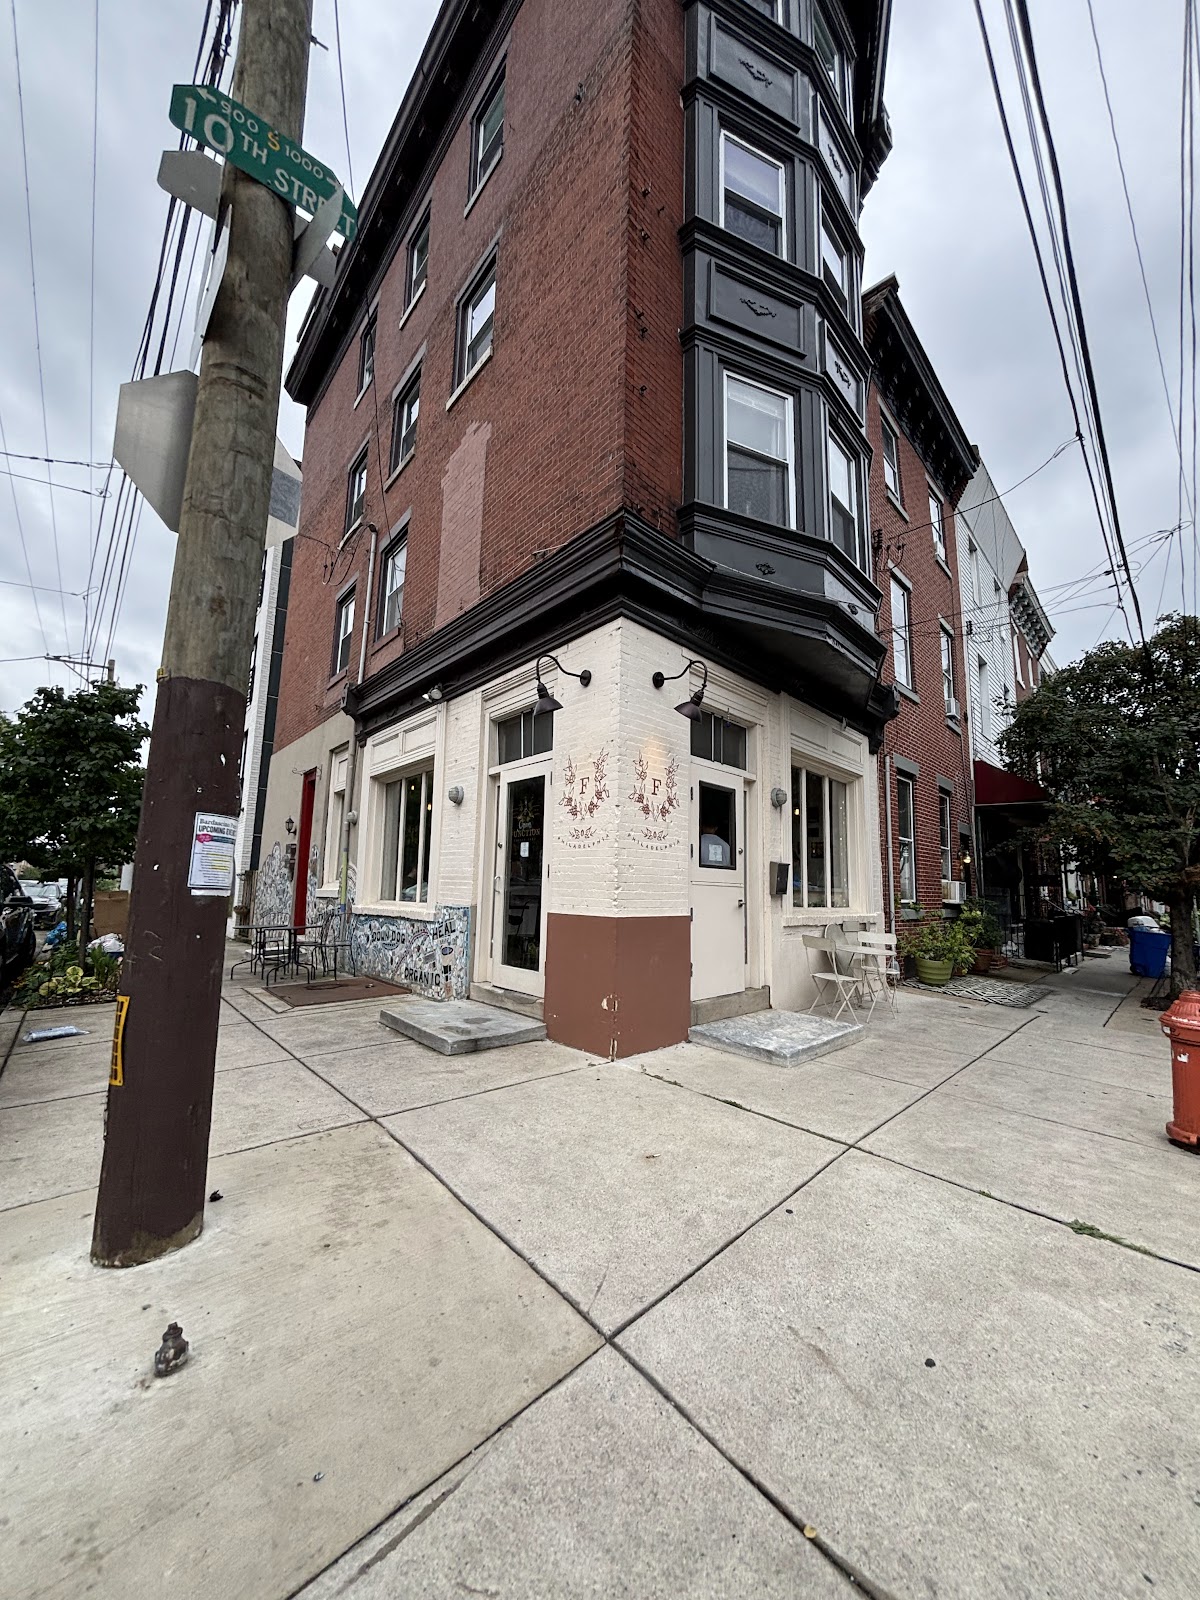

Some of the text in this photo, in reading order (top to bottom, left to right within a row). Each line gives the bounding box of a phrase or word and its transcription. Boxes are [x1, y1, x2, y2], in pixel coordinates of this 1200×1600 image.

[221, 101, 324, 180] 900 S 1000
[184, 96, 355, 236] 10TH STRT
[579, 777, 590, 795] F
[651, 778, 662, 796] F
[198, 825, 226, 835] UPCOMING
[557, 834, 610, 849] PHILADELPHIA
[627, 833, 680, 851] PHILADELPHIA
[371, 931, 406, 944] DOWN DOG
[404, 967, 440, 986] ORGANIC
